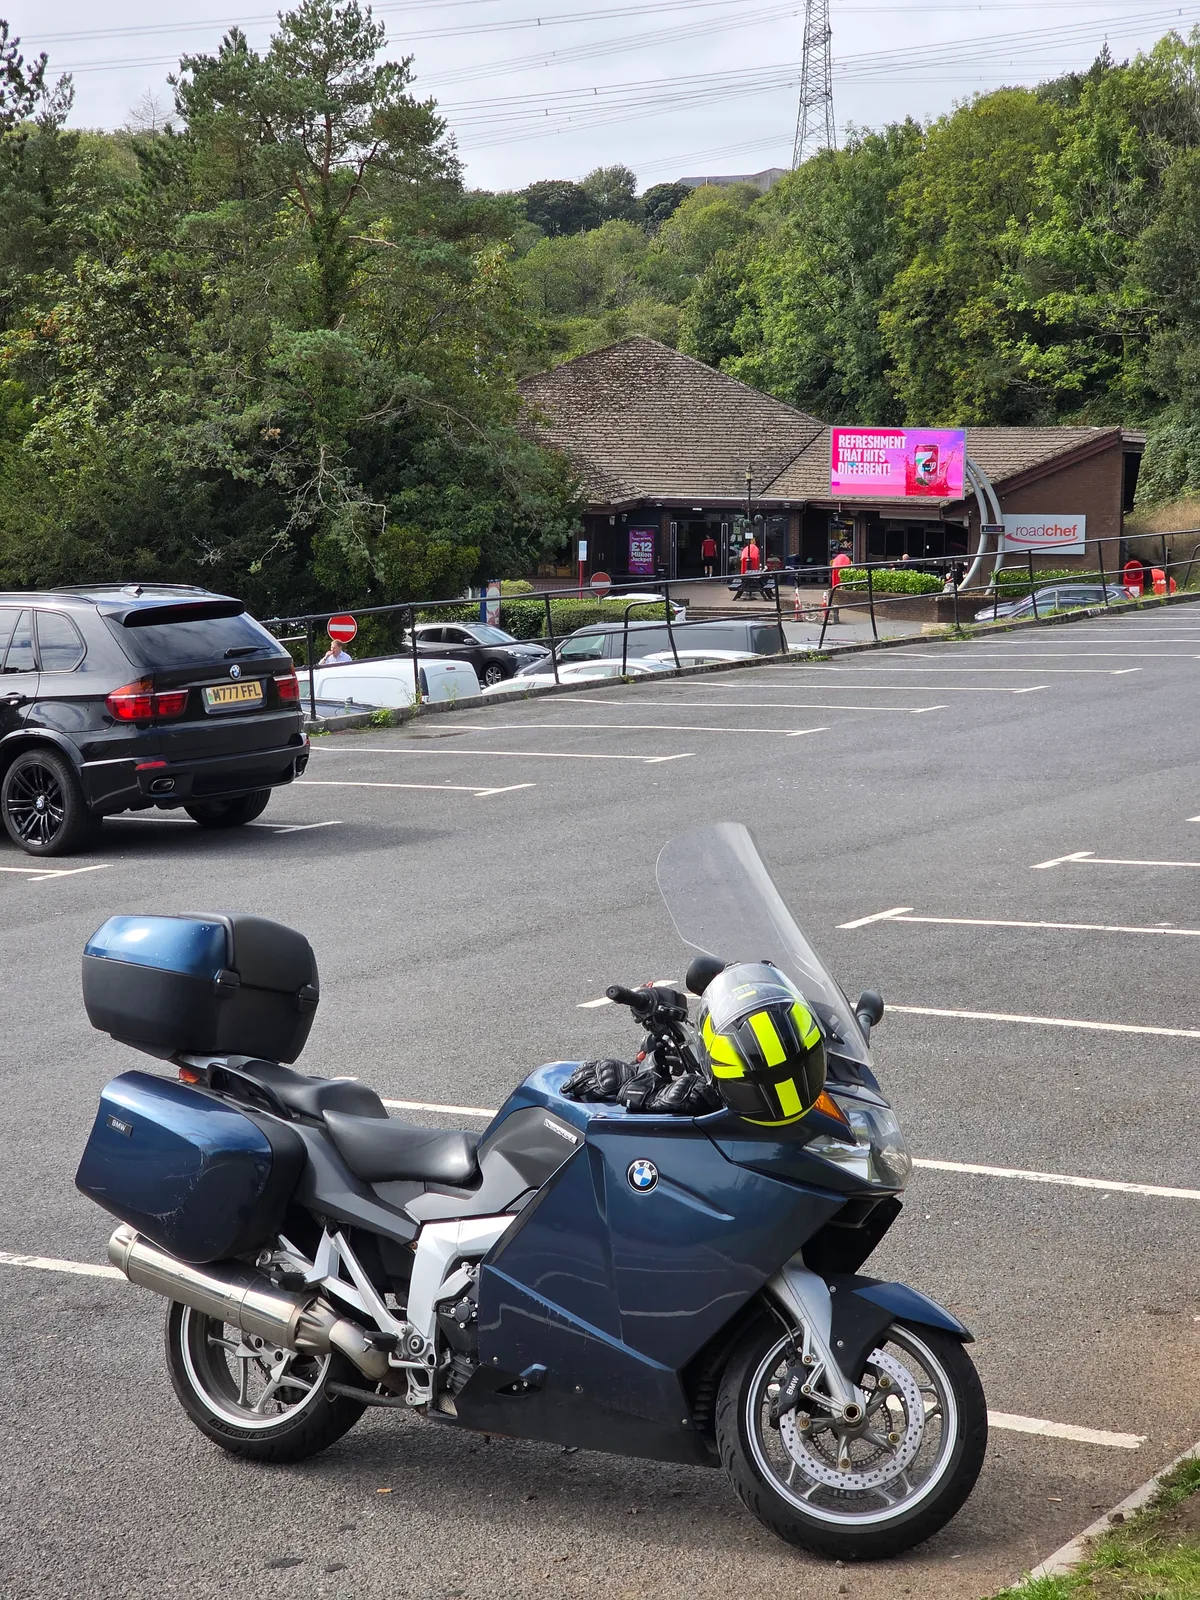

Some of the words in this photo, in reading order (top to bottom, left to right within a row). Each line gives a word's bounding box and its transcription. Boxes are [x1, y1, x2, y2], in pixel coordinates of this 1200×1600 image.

[838, 434, 907, 449] REFRESHMENT
[838, 449, 862, 462] THAT
[863, 449, 886, 462] HITS
[837, 461, 891, 476] DIFFERENT!
[1015, 524, 1078, 537] roadchef
[631, 542, 652, 552] £12
[240, 683, 261, 698] FFL
[111, 1119, 127, 1131] BMW
[786, 1375, 799, 1396] BMW
